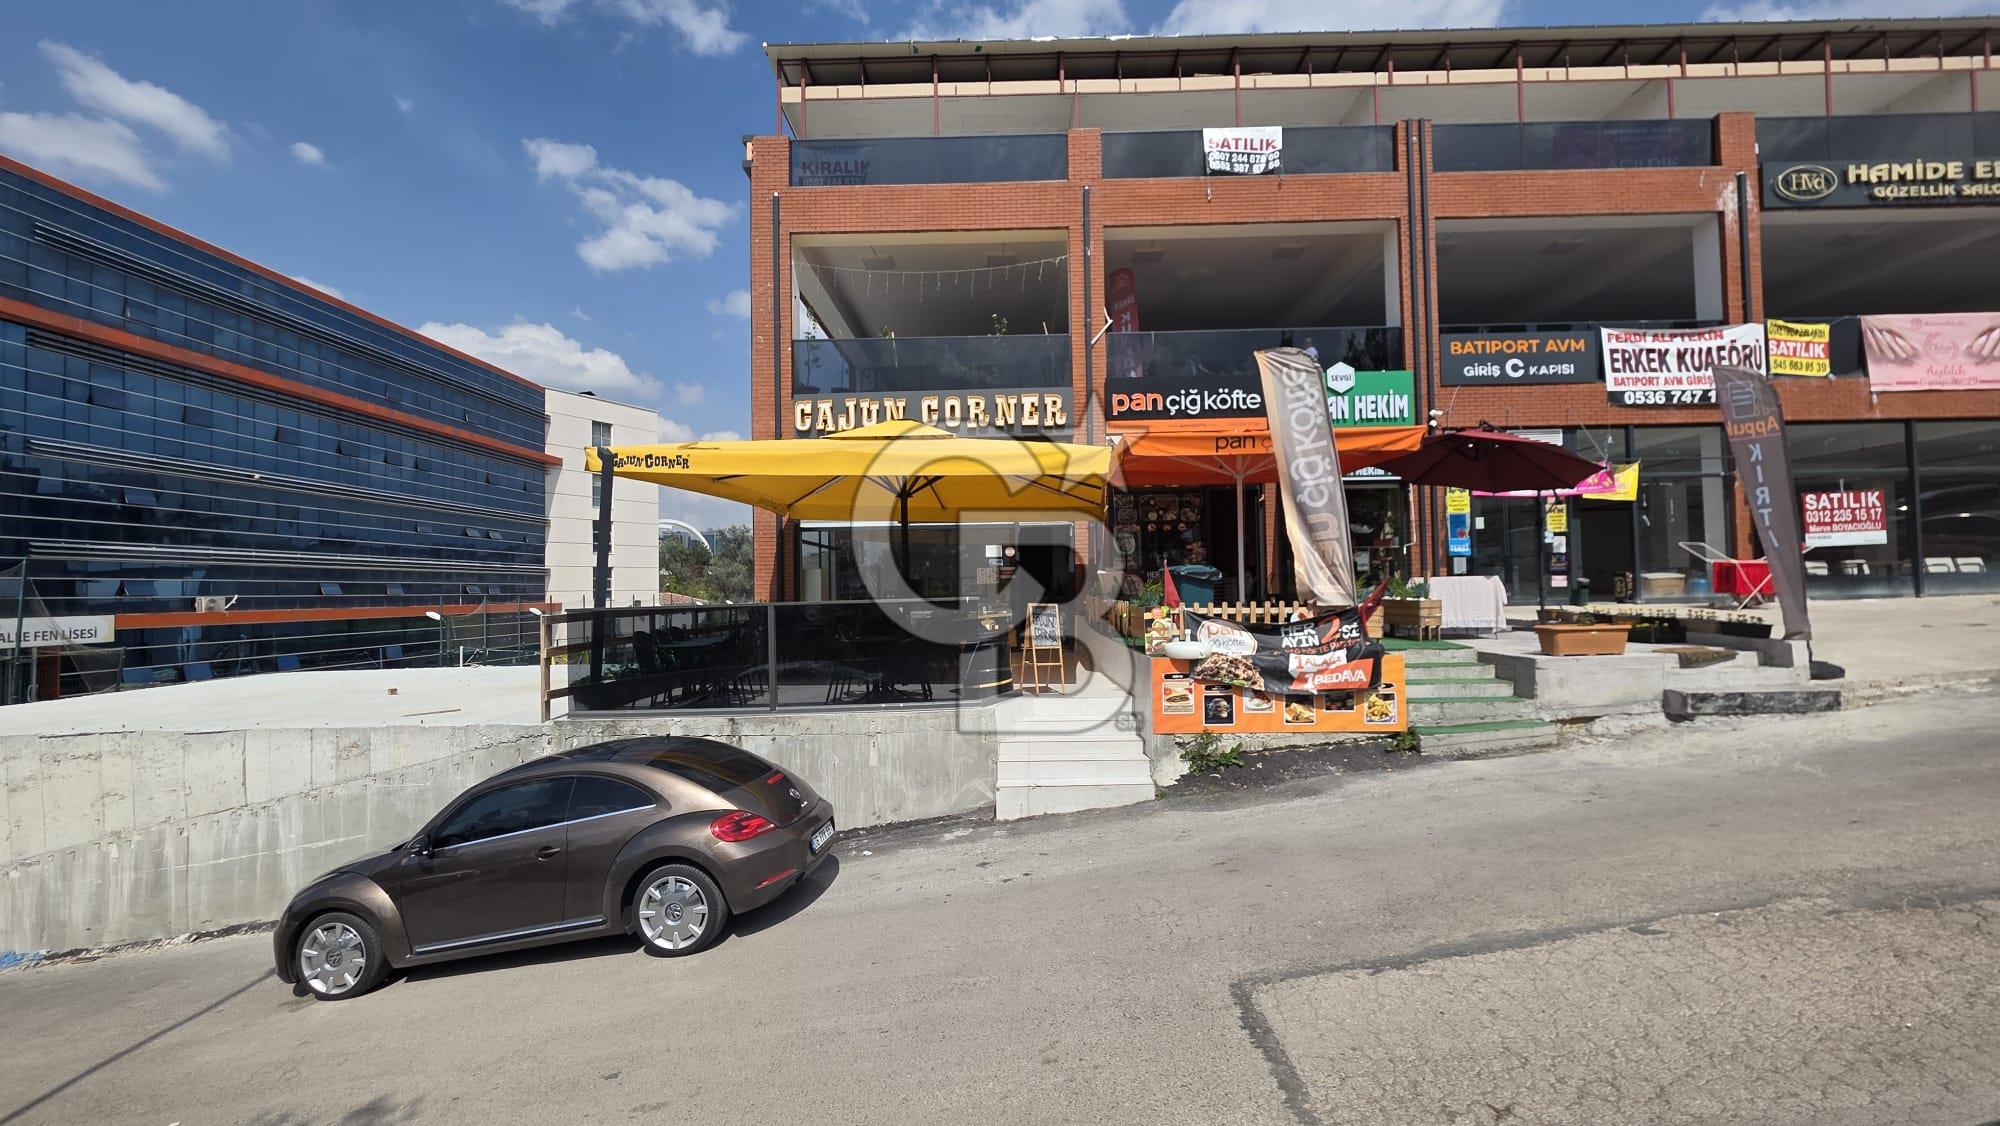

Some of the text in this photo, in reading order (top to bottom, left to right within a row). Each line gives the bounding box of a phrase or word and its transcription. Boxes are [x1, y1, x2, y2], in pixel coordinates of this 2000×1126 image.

[1208, 137, 1278, 151] SATILIK
[1848, 158, 1965, 184] HAMİDE
[1873, 182, 1956, 201] GÜZELLİK
[1451, 338, 1586, 355] BATIPORT AVM
[1769, 340, 1825, 359] SATILIK
[1609, 339, 1763, 374] ERKEK KUAFÖRÜ
[1463, 358, 1575, 378] GİRİŞ C KAPISI
[1331, 373, 1352, 382] SEVGİ
[1613, 376, 1660, 387] BATIPORT
[1663, 375, 1684, 386] AVM
[1112, 388, 1262, 416] pan çiğ köfte
[1328, 389, 1409, 421] AN HEKİM
[1624, 390, 1666, 405] 0536
[1671, 390, 1703, 404] 747
[794, 394, 1067, 432] CAJUN CORNER
[1215, 435, 1256, 452] pan
[645, 454, 689, 469] CORNER
[1805, 491, 1881, 510] SATILIK
[1806, 507, 1882, 523] 0312 235 15 17
[0, 626, 97, 644] ALE FEN LİSESİ
[1281, 622, 1316, 637] HER
[1282, 633, 1320, 648] AYIN
[1314, 668, 1367, 685] BEDAVA
